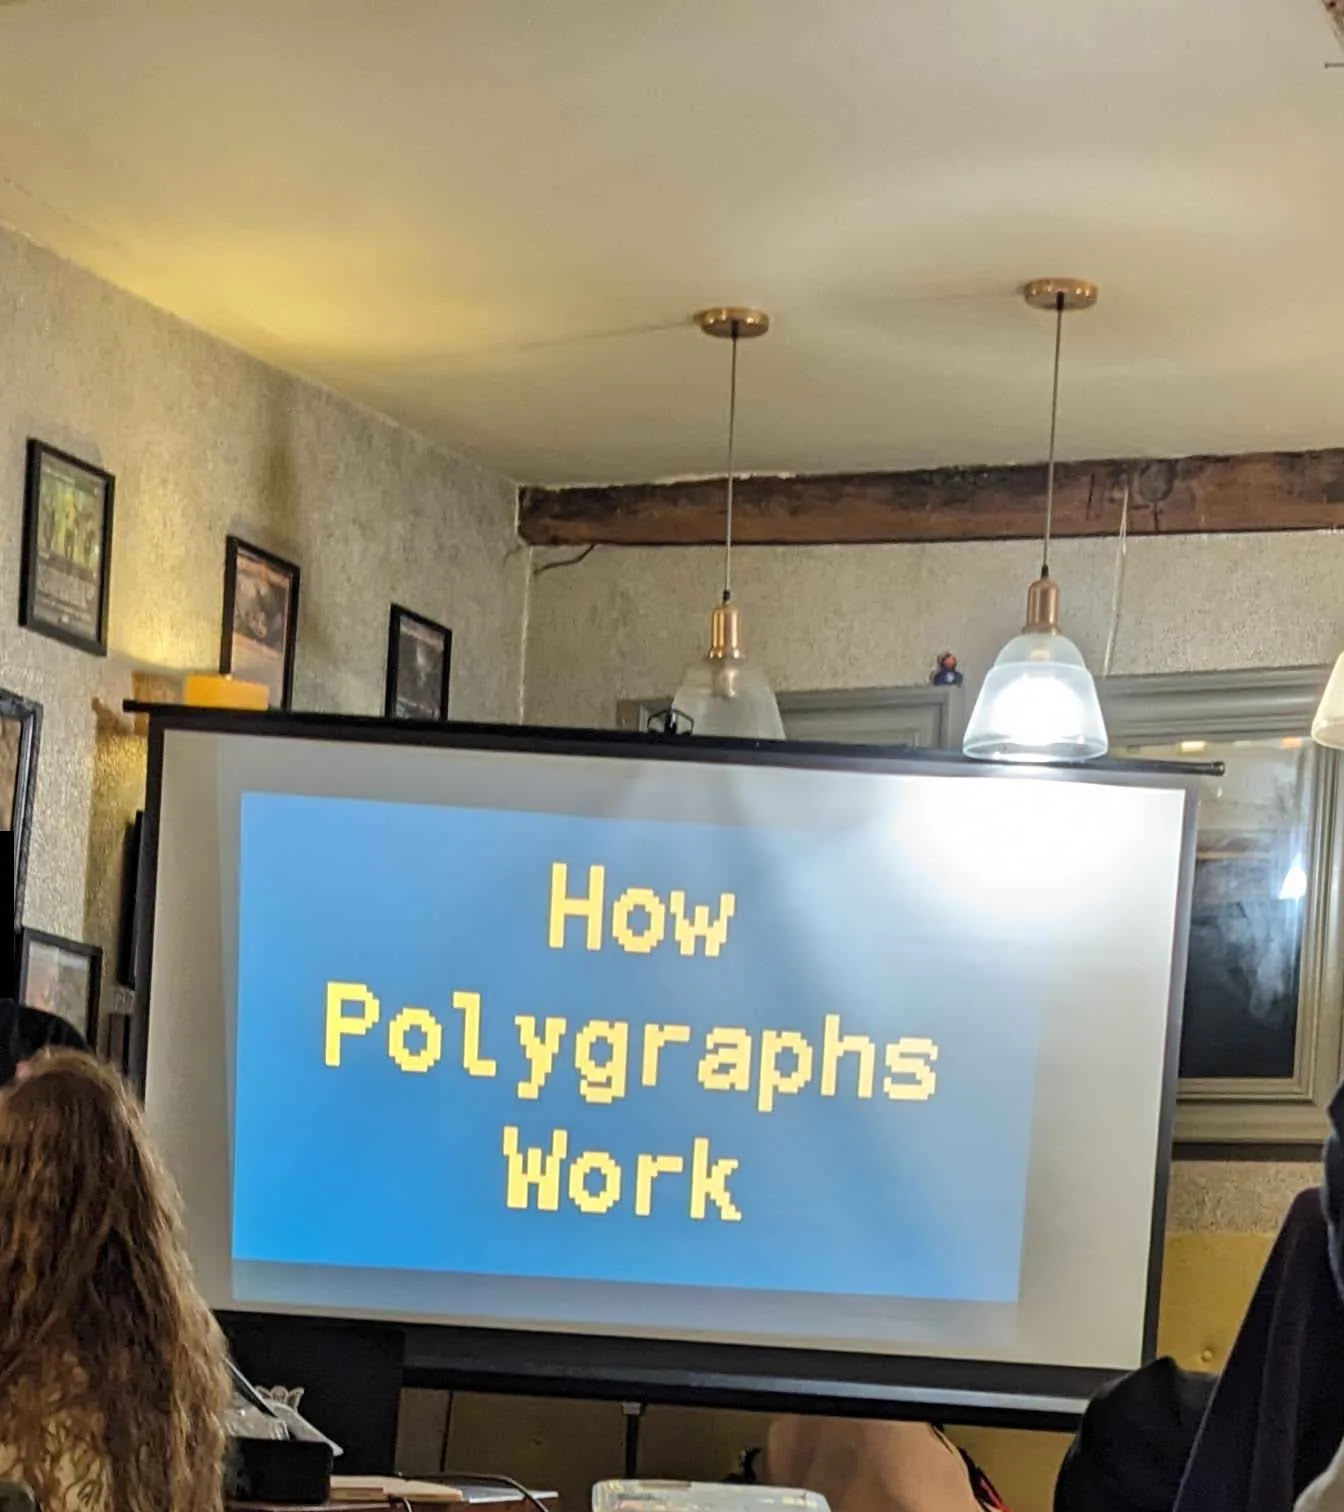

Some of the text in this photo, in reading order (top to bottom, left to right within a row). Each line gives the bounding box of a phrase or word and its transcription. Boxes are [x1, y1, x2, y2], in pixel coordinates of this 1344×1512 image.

[548, 862, 737, 958] How
[324, 981, 941, 1114] Polygraphs
[502, 1125, 744, 1223] Work
